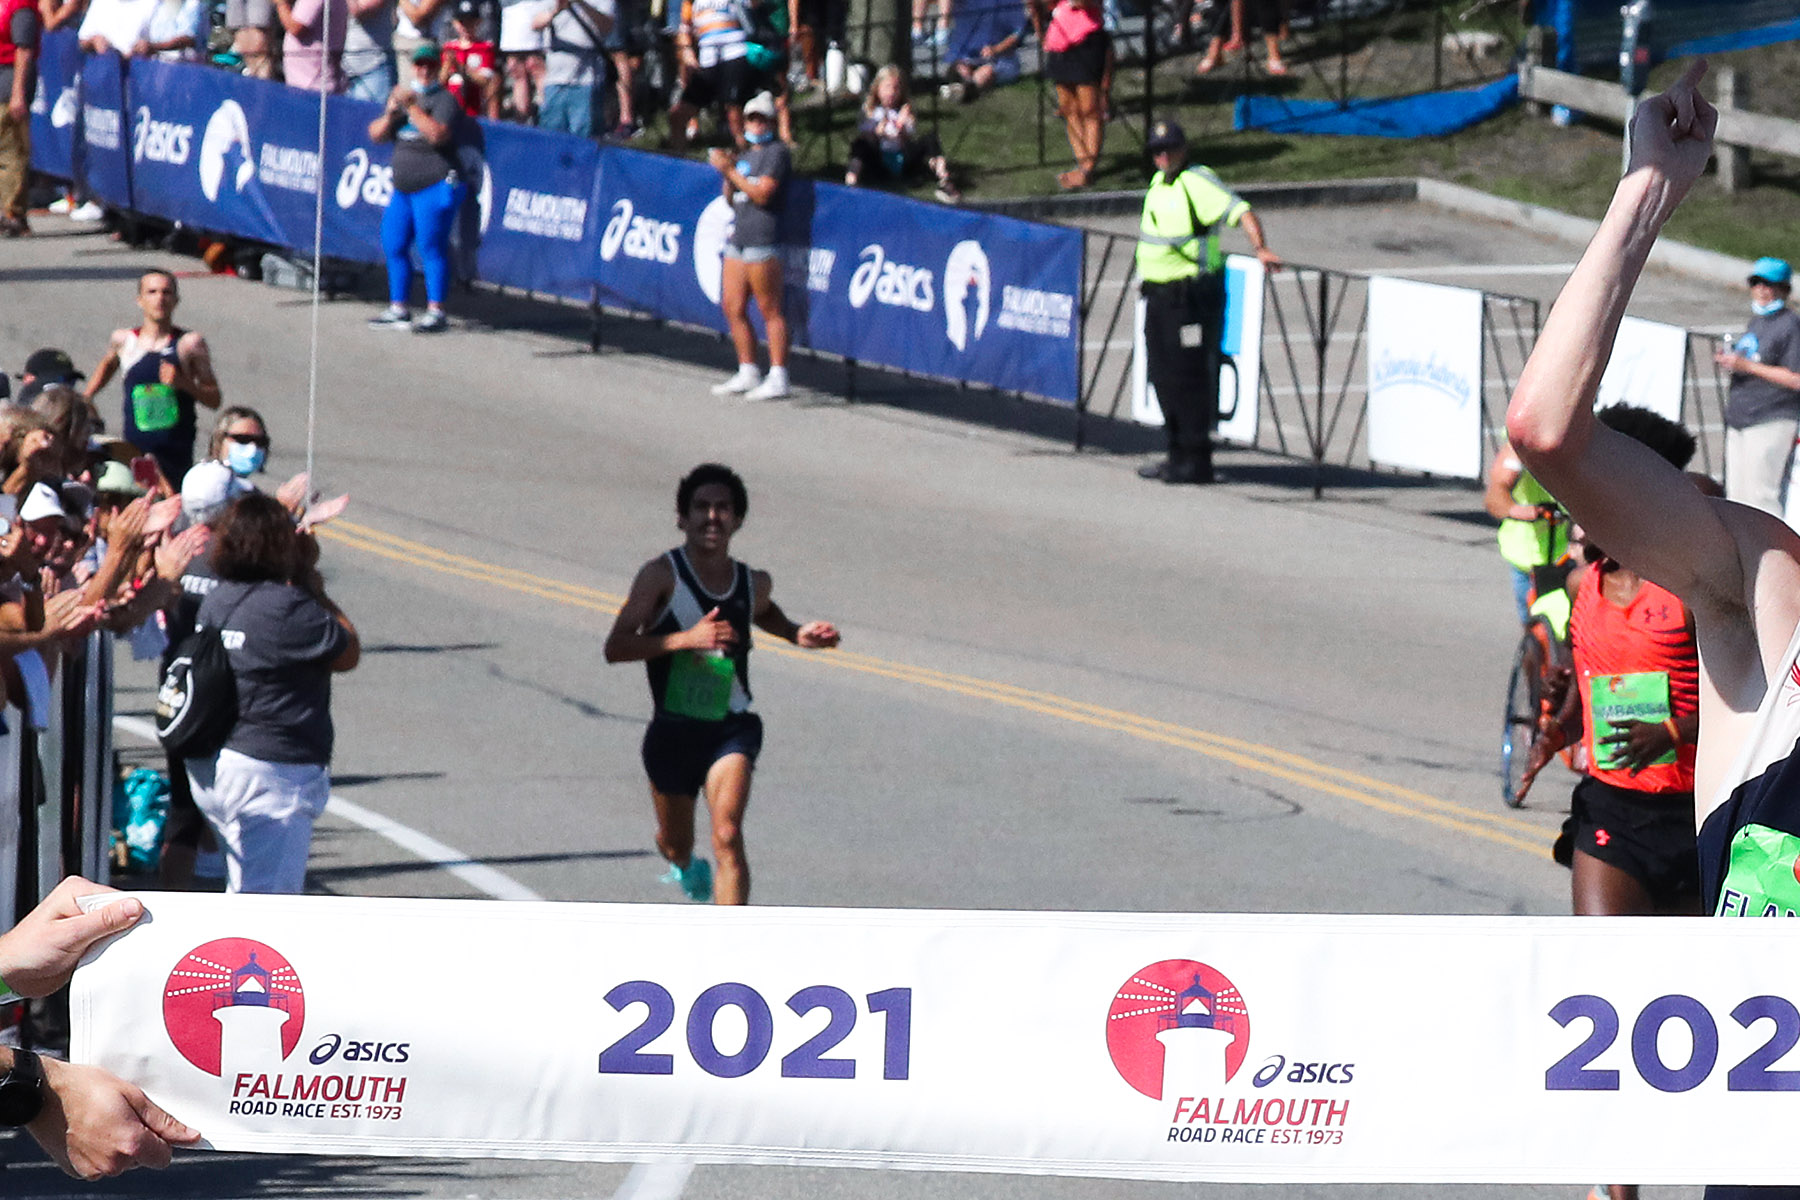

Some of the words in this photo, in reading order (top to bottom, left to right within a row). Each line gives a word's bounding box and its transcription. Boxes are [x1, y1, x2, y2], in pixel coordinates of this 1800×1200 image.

[624, 214, 681, 264] asics
[875, 260, 934, 312] asics
[598, 980, 912, 1078] 2021
[343, 1041, 410, 1062] asics
[1287, 1062, 1355, 1083] asics
[233, 1073, 407, 1103] FALMOUTH
[229, 1101, 277, 1115] ROAD
[282, 1102, 326, 1118] RACE
[330, 1104, 362, 1119] EST.
[365, 1106, 402, 1120] 1973
[1173, 1097, 1350, 1126] FALMOUTH
[1167, 1127, 1217, 1142] ROAD
[1221, 1128, 1266, 1144] RACE
[1270, 1129, 1302, 1144] EST.
[1305, 1130, 1344, 1145] 1973
